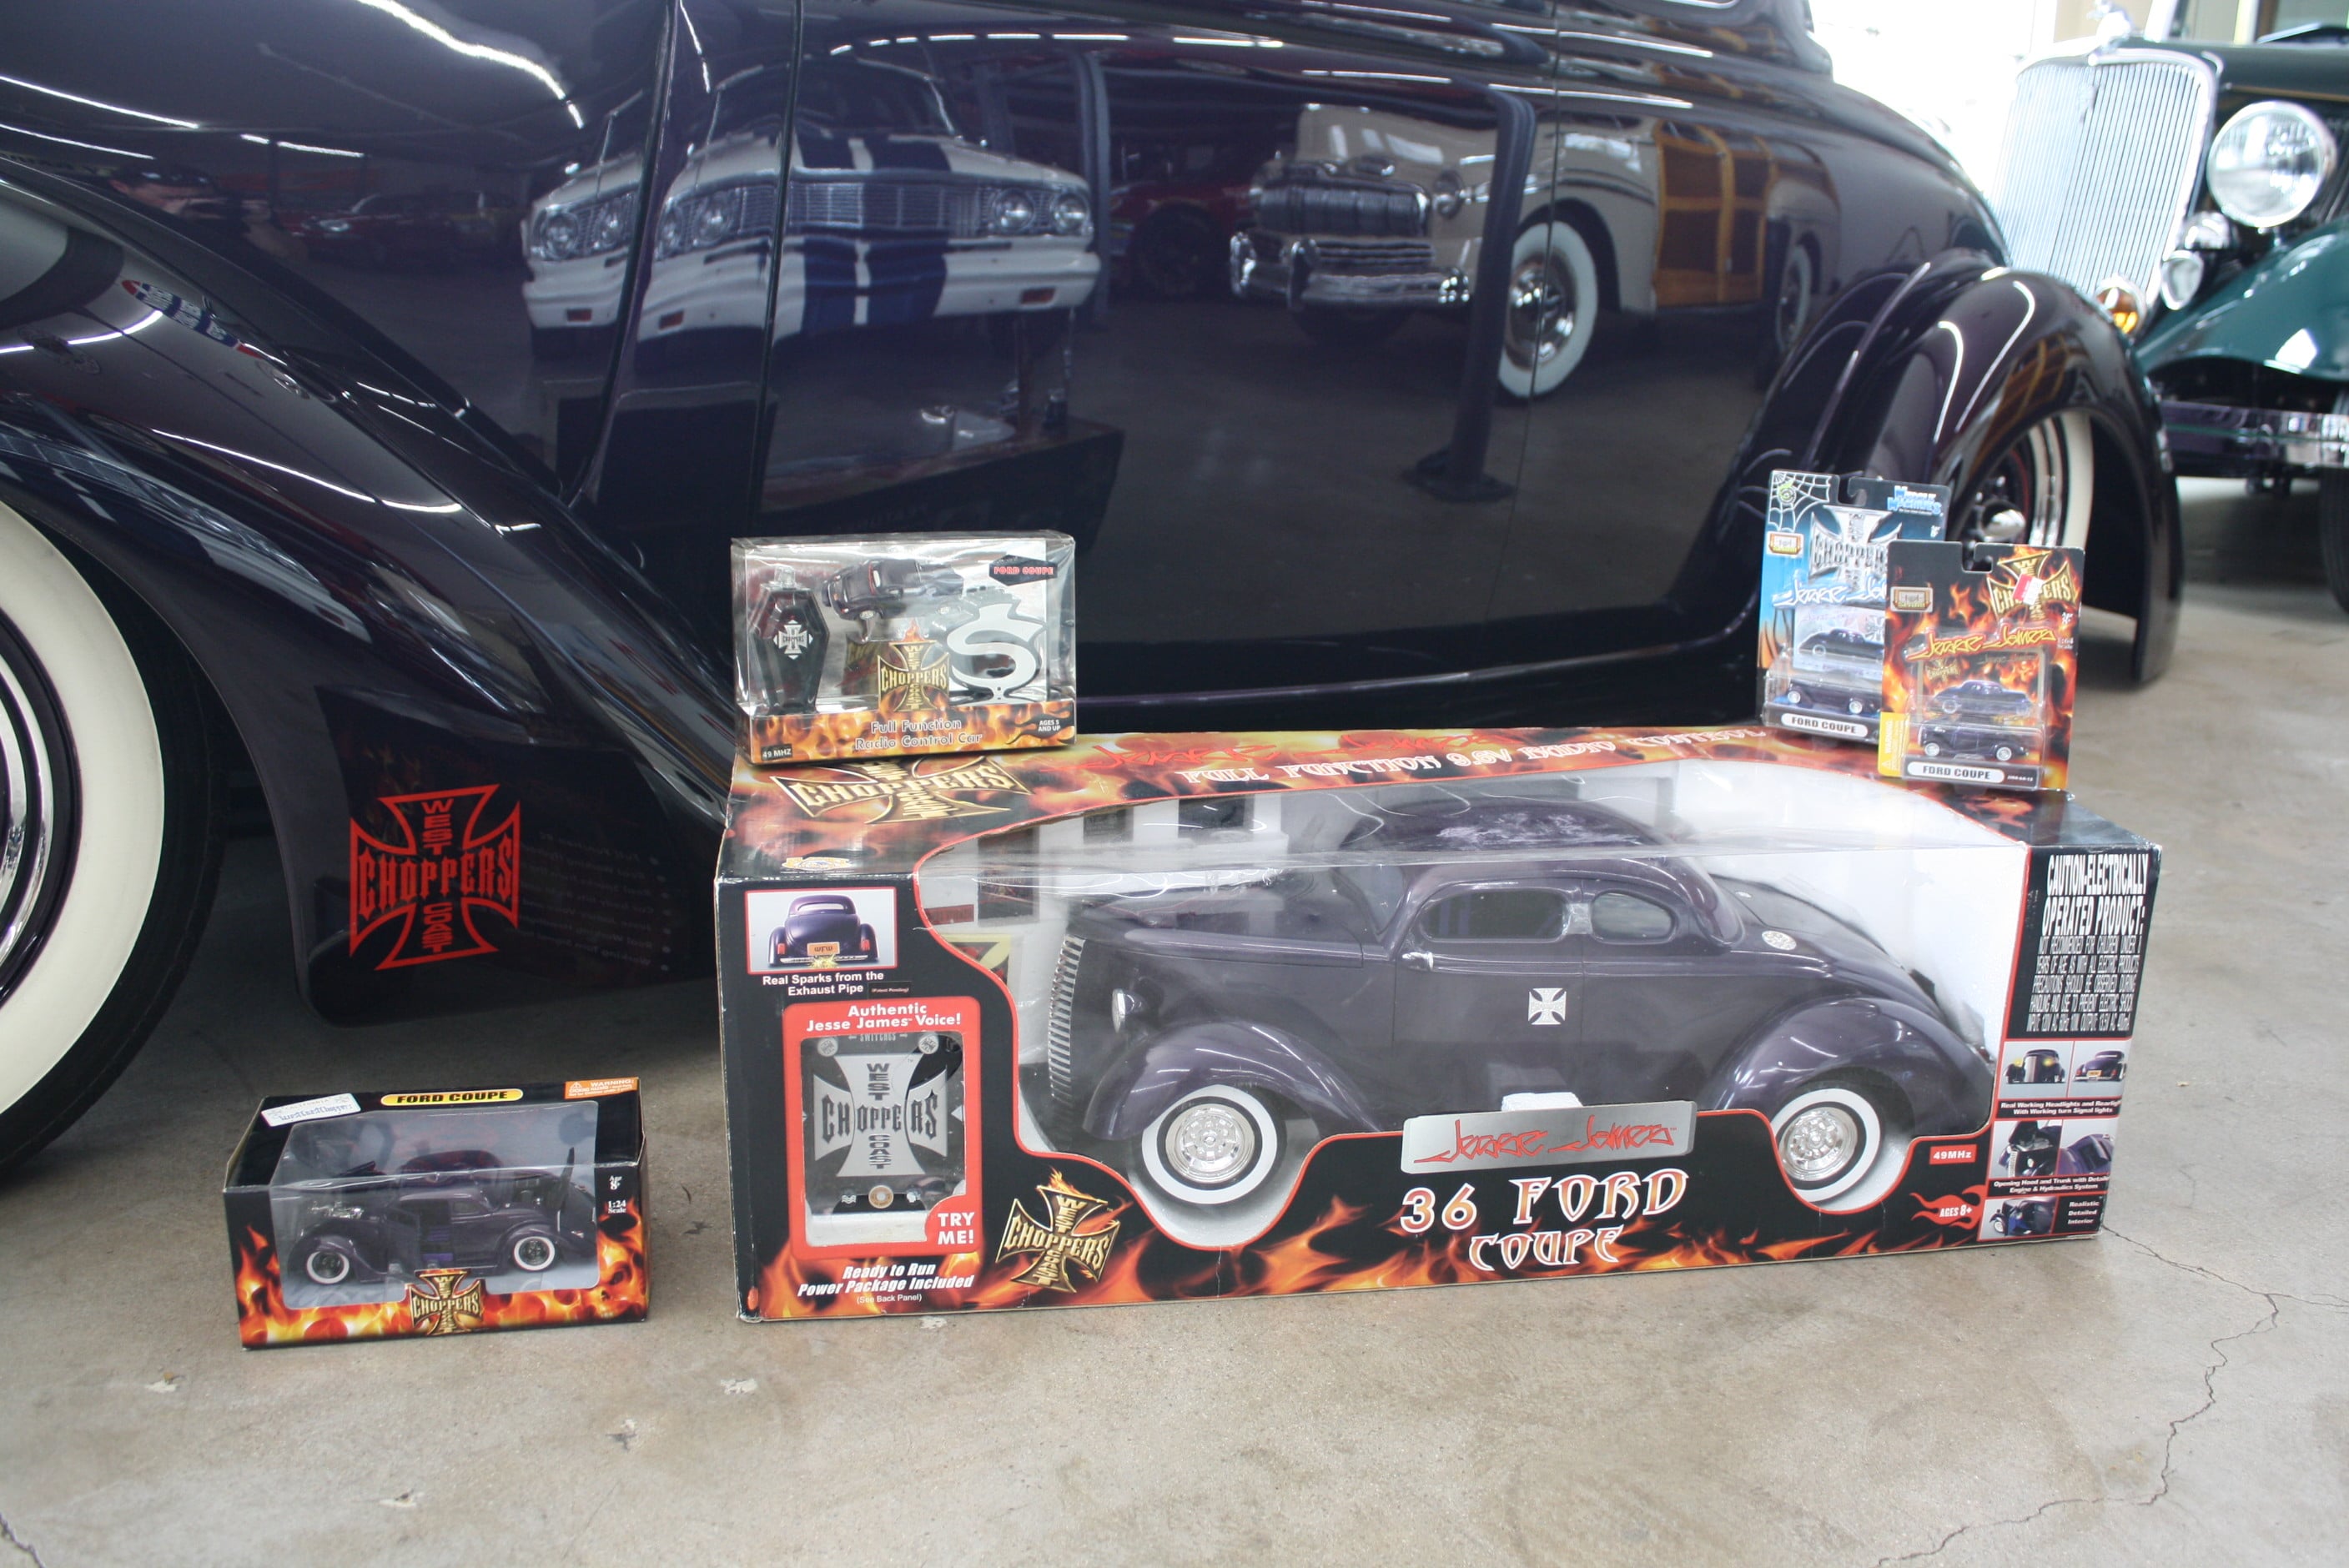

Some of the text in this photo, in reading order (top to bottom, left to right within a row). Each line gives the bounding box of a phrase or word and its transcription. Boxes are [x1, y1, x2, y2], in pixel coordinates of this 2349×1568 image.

[1813, 532, 1888, 570] CHOPPER
[993, 565, 1054, 575] FORD COUPE
[1993, 574, 2072, 614] CHERS
[1906, 624, 2058, 661] Jesse James
[881, 663, 948, 692] CHOPPERS
[871, 718, 963, 734] Full Function
[1791, 716, 1857, 734] FORD COUPE
[762, 748, 792, 760] 49 MHZ
[855, 731, 983, 750] Radio Control Car
[1174, 728, 1767, 784] FULL FUNCTION 9.6V RADIO CONTROL
[788, 763, 1017, 807] CHOPPERS
[1922, 765, 1991, 780] FORD COUPE
[420, 797, 455, 856] WEST
[357, 832, 514, 920] CHOPPERS
[421, 902, 454, 953] COAST
[2041, 895, 2145, 937] OPERATED PRODUCT:
[762, 971, 884, 986] Real Sparks from the
[787, 985, 835, 997] Exhaust
[837, 983, 864, 996] Pipe
[806, 1019, 851, 1033] Jesse
[915, 1013, 962, 1027] Voice!
[848, 1003, 928, 1018] Authentic
[867, 1063, 891, 1101] WEST
[396, 1090, 509, 1103] FORD COUPE
[822, 1088, 938, 1143] CHOPPERS
[868, 1134, 893, 1169] COAST
[1413, 1114, 1675, 1163] Jesse James
[1932, 1150, 1973, 1160] 49MHz
[607, 1199, 626, 1209] 1:24
[1055, 1194, 1087, 1234] WEST
[1399, 1167, 1690, 1234] 36 FORD
[1939, 1204, 1973, 1218] AGES 8+
[937, 1211, 975, 1227] TRY
[937, 1229, 974, 1245] ME!
[1003, 1214, 1110, 1270] CHOPPERS
[1468, 1224, 1625, 1272] COUPE
[842, 1263, 936, 1280] Ready to Run
[1032, 1249, 1062, 1286] COAST
[797, 1274, 975, 1297] Power Package Included
[856, 1293, 923, 1305] (See Back Panel)
[412, 1291, 480, 1319] CHOPPERS
